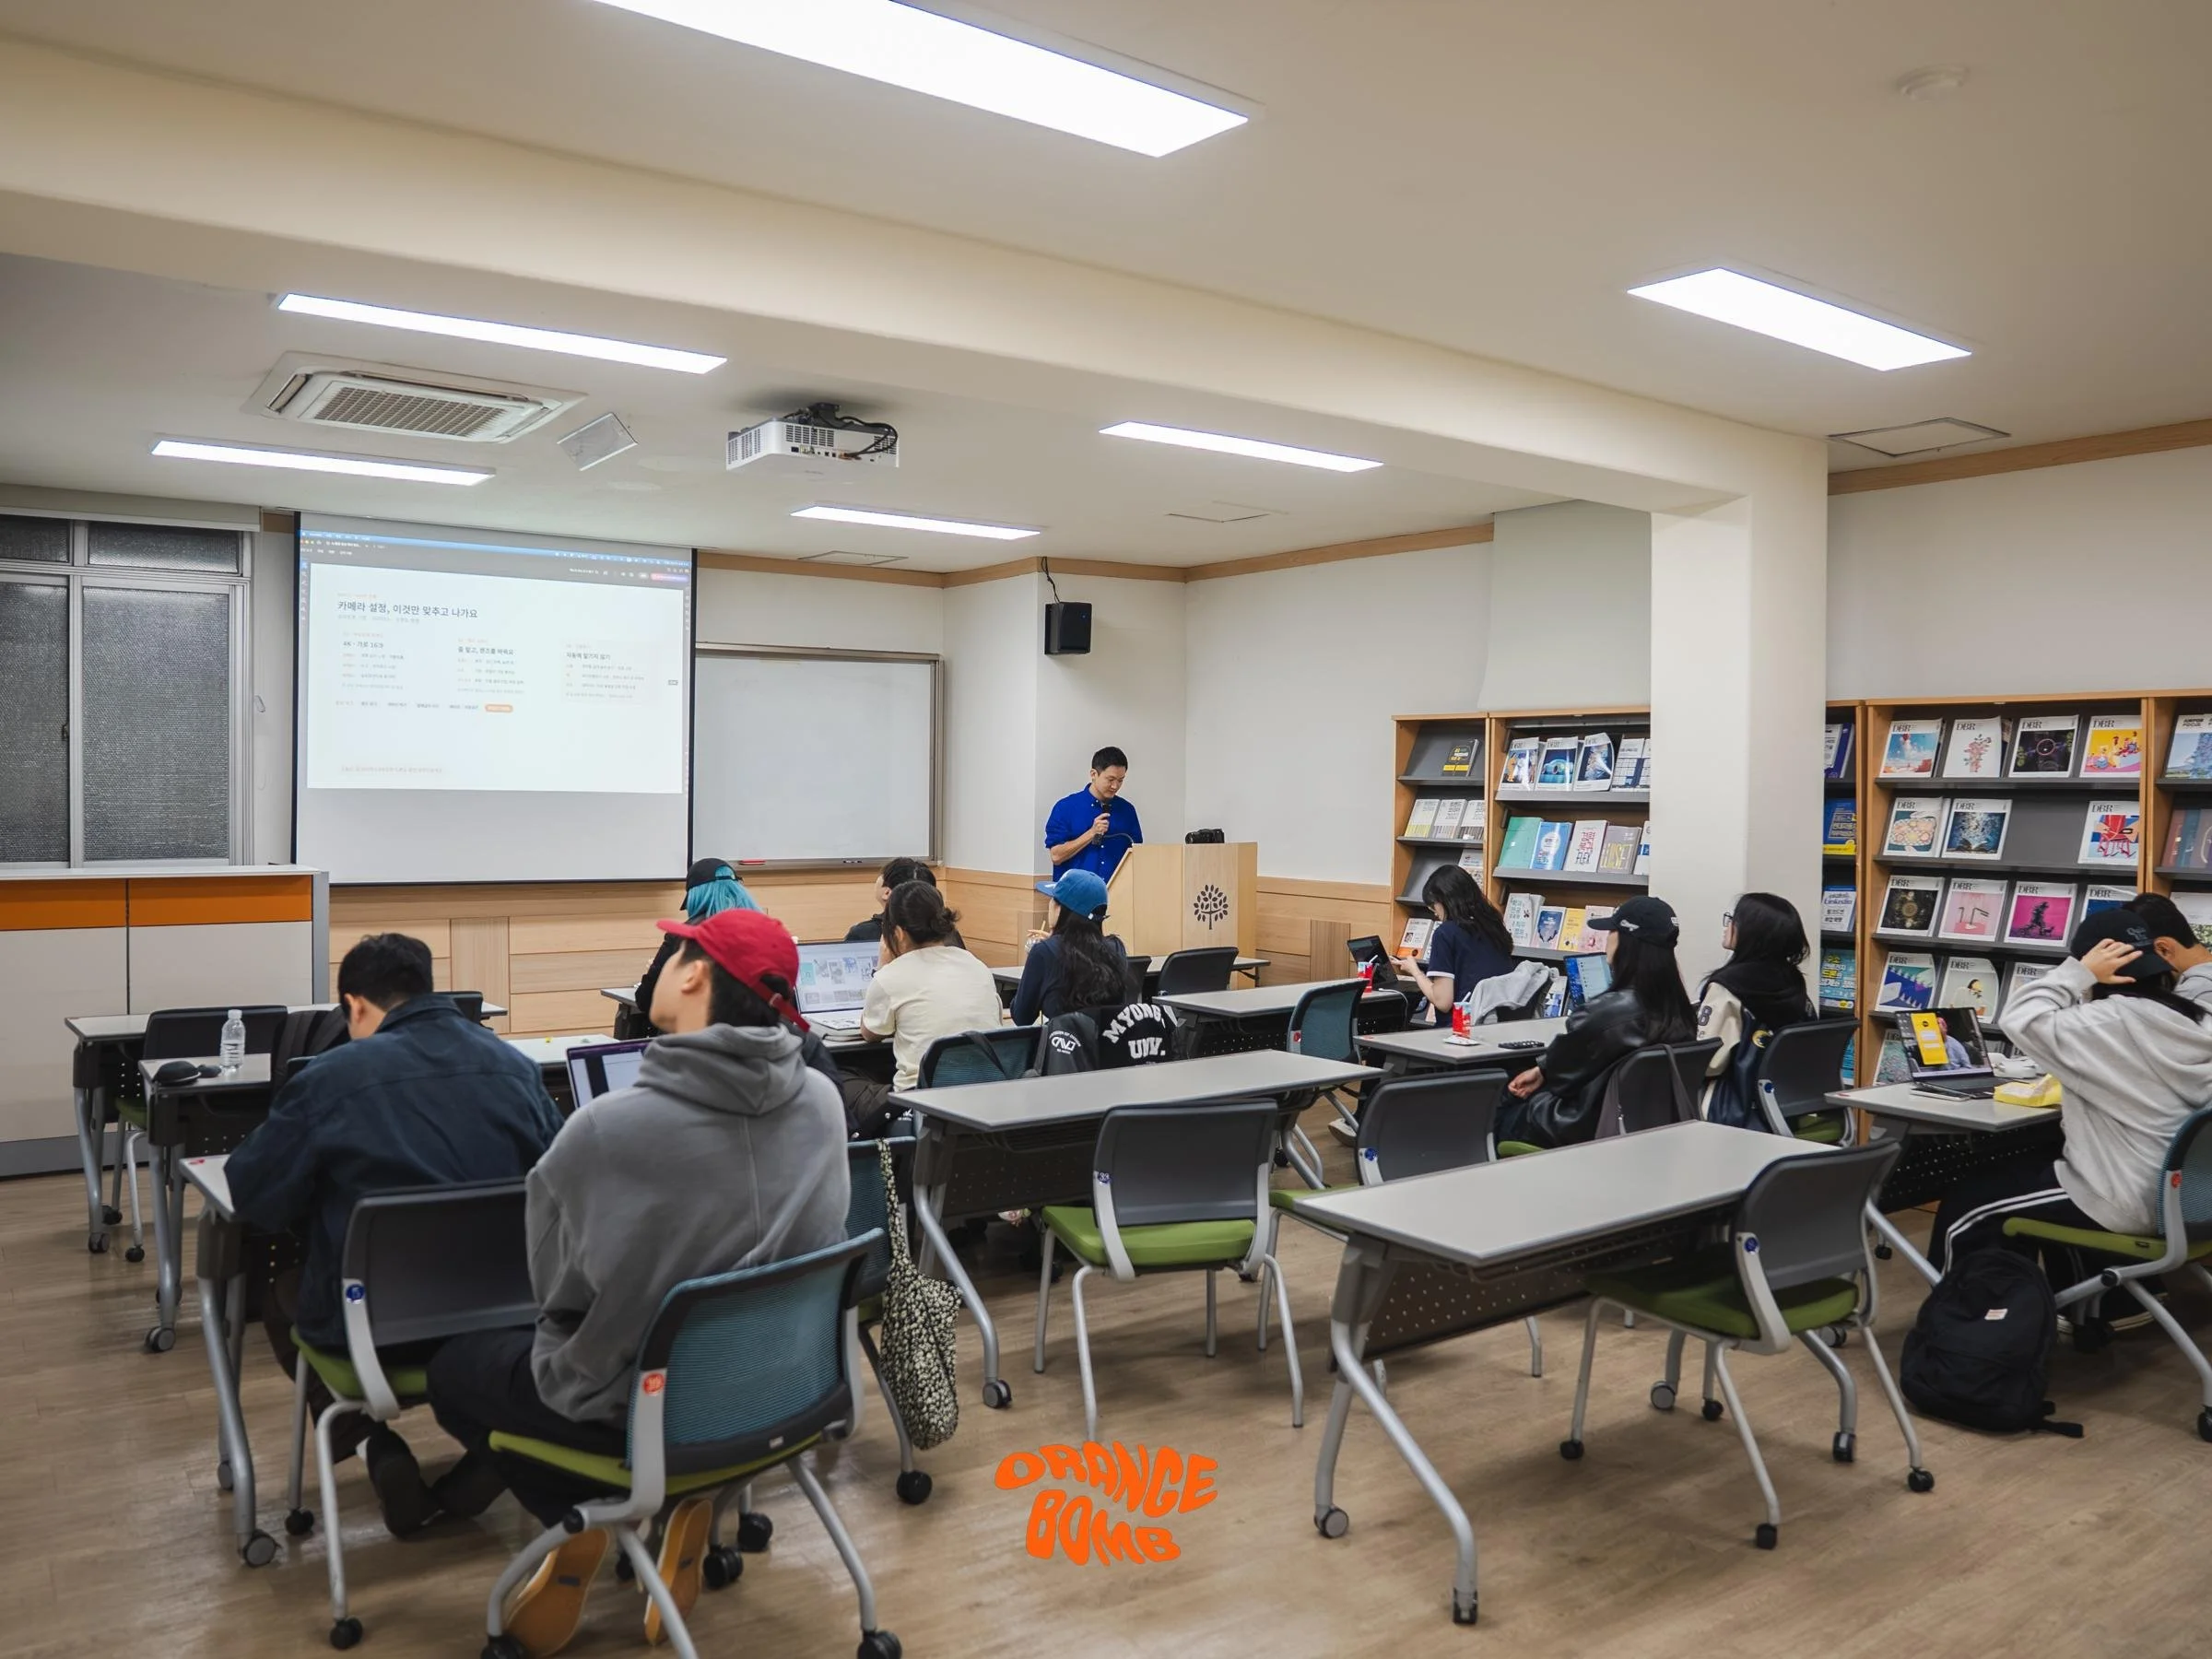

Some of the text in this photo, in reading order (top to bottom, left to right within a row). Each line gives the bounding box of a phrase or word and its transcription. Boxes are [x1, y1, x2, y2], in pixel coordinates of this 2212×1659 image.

[337, 601, 478, 618] 카메라 설정, 이것만 맞추고 나가요
[2021, 721, 2042, 729] DBR
[2092, 720, 2115, 728] DBR
[1897, 801, 1915, 809] DBR
[2091, 804, 2114, 812] DBR
[1890, 878, 1910, 887] DBR
[1952, 881, 1973, 890] DBR
[2018, 886, 2040, 894] DBR
[2088, 888, 2112, 898] DBR
[1888, 956, 1908, 964] DBR
[1950, 960, 1970, 970] DBR
[2016, 966, 2037, 975] DBR
